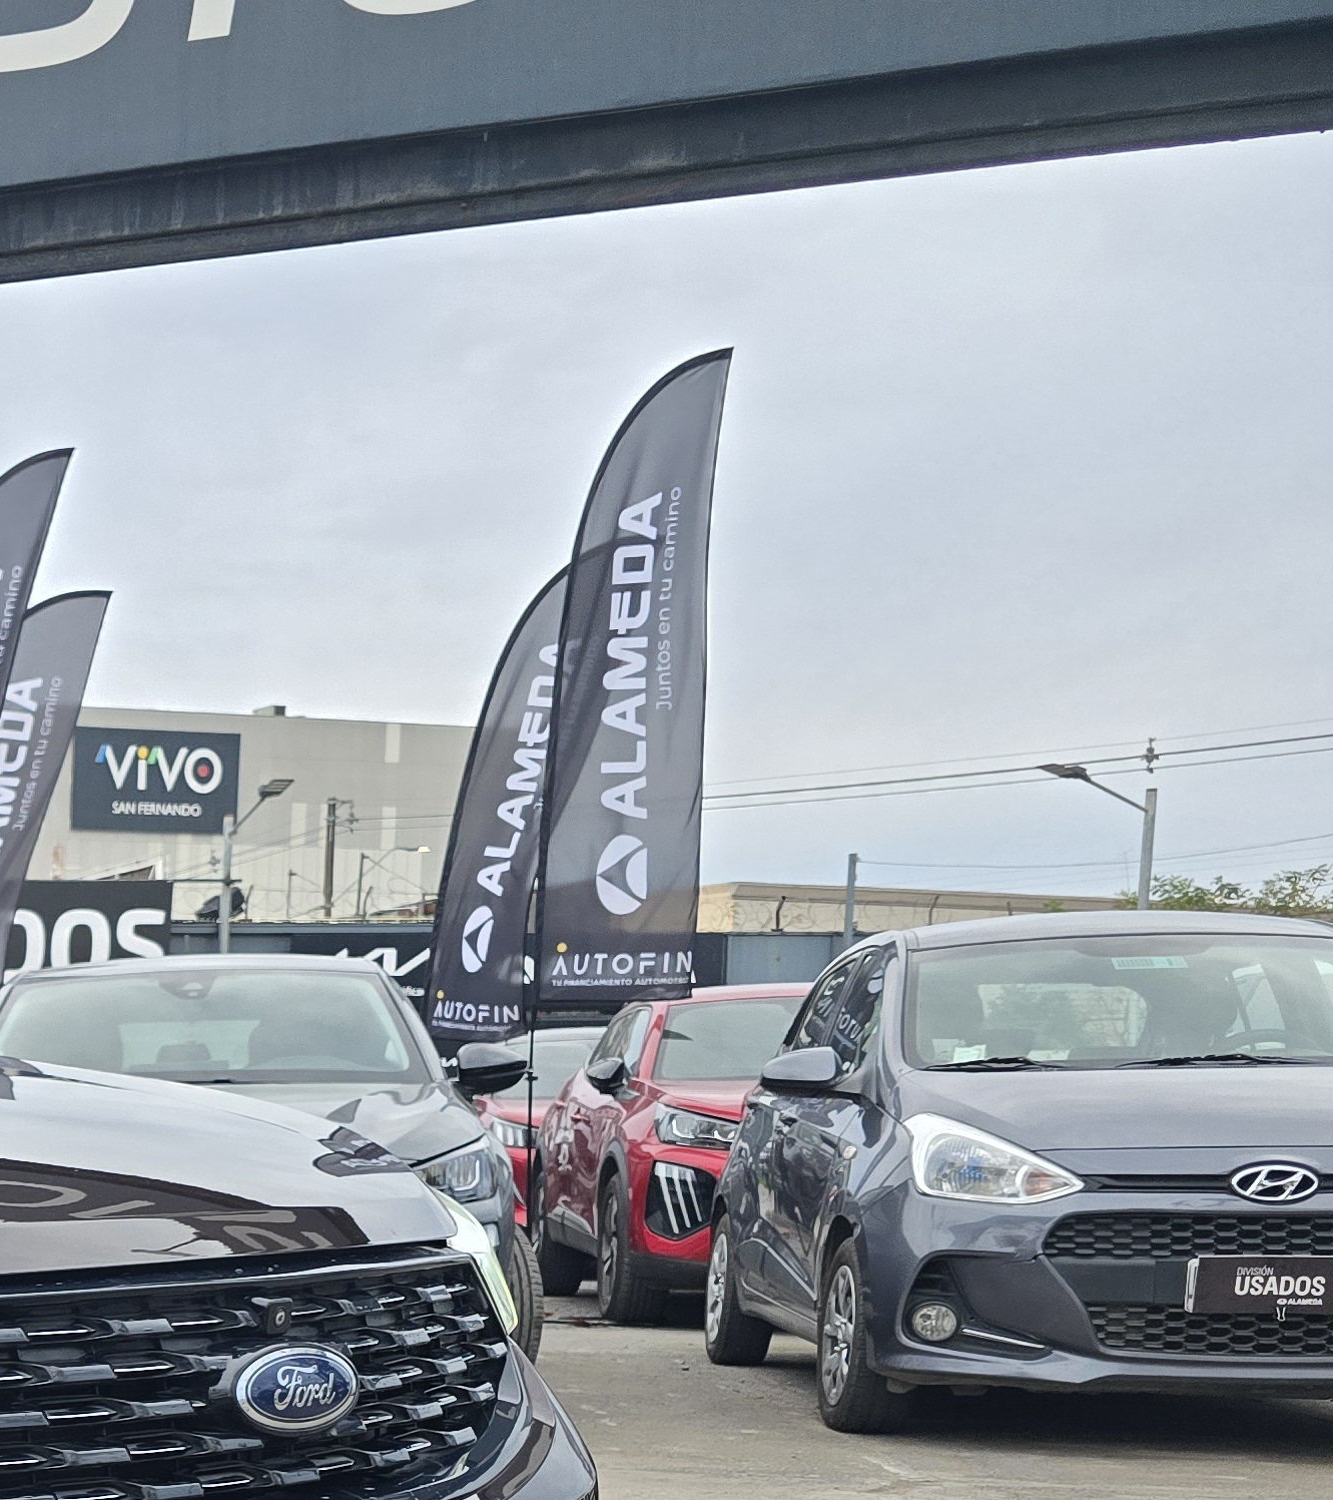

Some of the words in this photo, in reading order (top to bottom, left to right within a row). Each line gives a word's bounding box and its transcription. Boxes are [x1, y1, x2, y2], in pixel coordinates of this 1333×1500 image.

[662, 486, 682, 571] camino
[658, 578, 673, 602] tu
[658, 607, 671, 635] en
[600, 491, 663, 820] ALAMEDA
[655, 639, 673, 710] Juntos
[111, 800, 136, 815] SAN
[137, 801, 202, 818] FERNANDO
[552, 951, 692, 976] AUTOFIN
[433, 1000, 520, 1023] AUTOFIN
[1236, 1265, 1274, 1276] DIVISIÓN
[1234, 1275, 1326, 1296] USADOS
[273, 1364, 336, 1411] Ford
